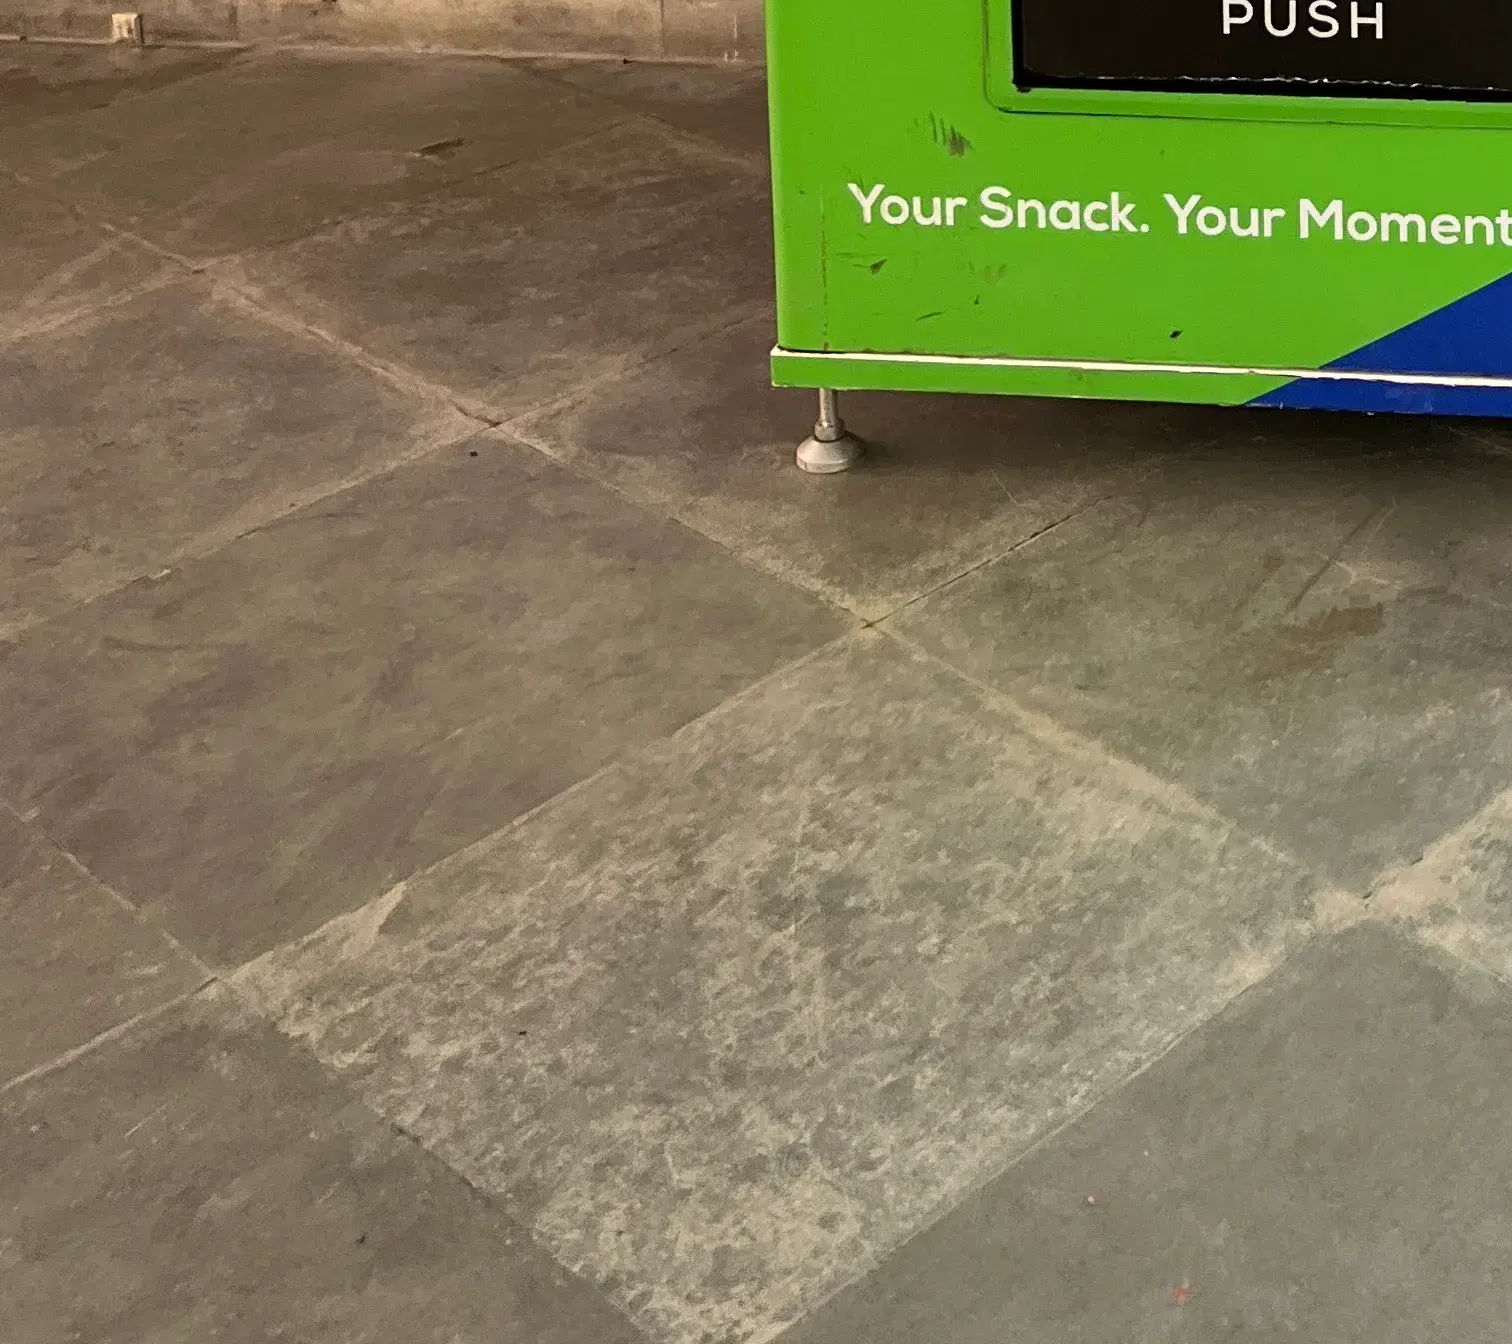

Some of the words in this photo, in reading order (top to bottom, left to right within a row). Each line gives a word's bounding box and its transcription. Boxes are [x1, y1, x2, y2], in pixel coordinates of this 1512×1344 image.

[848, 183, 967, 225] Your
[980, 186, 1149, 232] Snack.
[1163, 193, 1285, 237] Your
